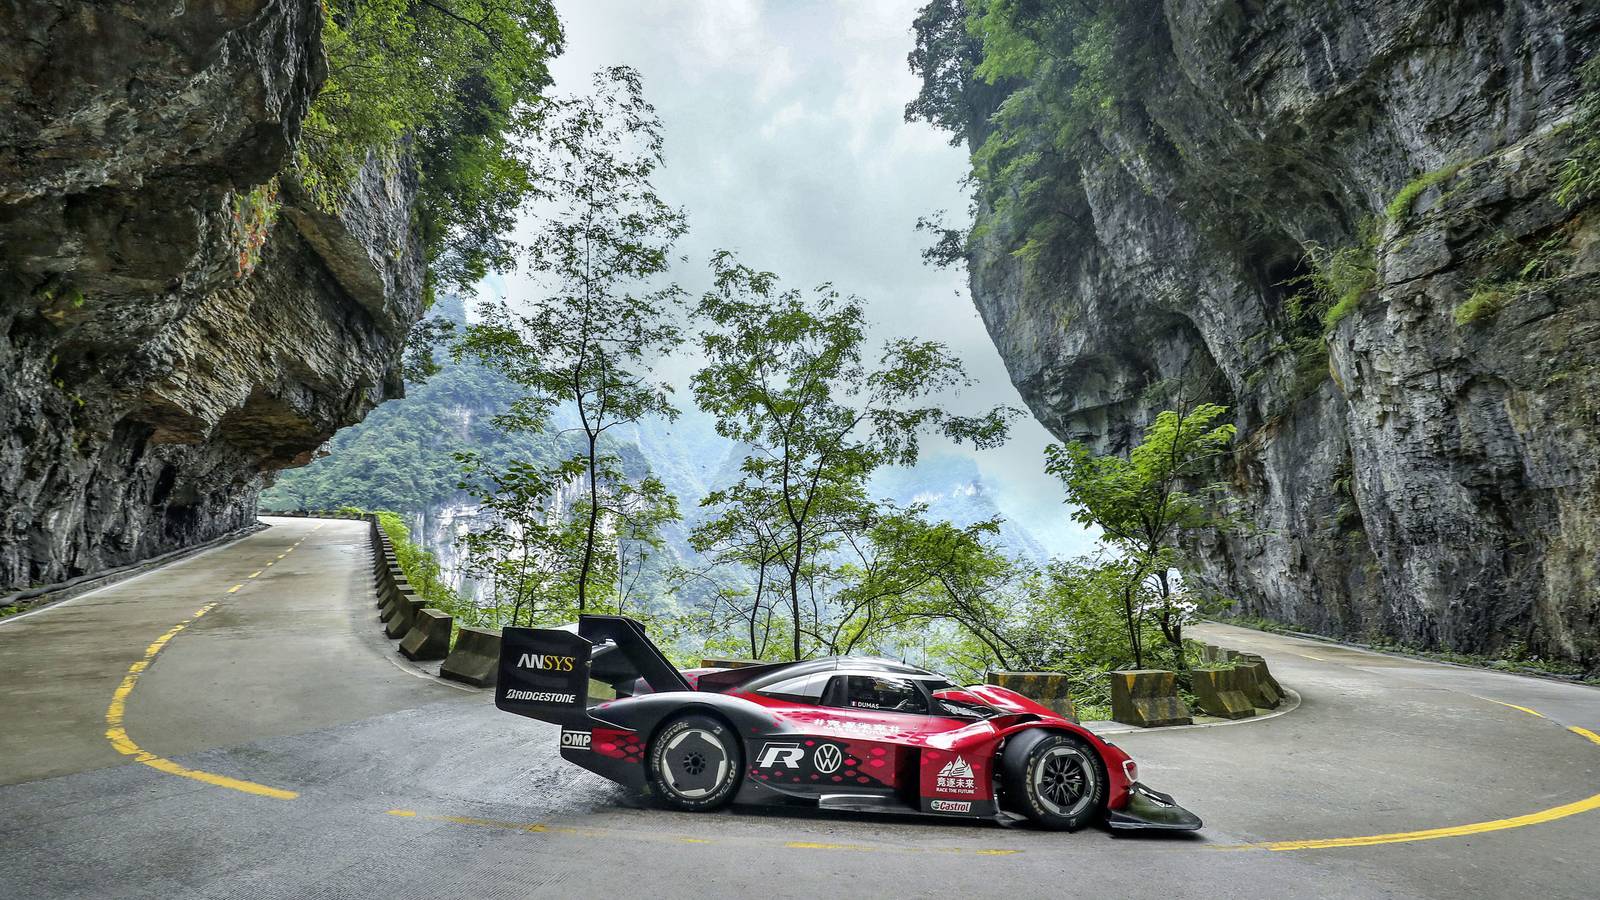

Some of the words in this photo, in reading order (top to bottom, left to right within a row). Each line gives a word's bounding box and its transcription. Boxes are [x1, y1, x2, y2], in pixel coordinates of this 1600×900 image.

[517, 653, 573, 671] ANSYS
[505, 688, 576, 703] BRIDGESTONE
[857, 701, 880, 710] DUMAS
[562, 733, 592, 746] OMP
[759, 746, 805, 769] R
[940, 802, 970, 812] Castrol
